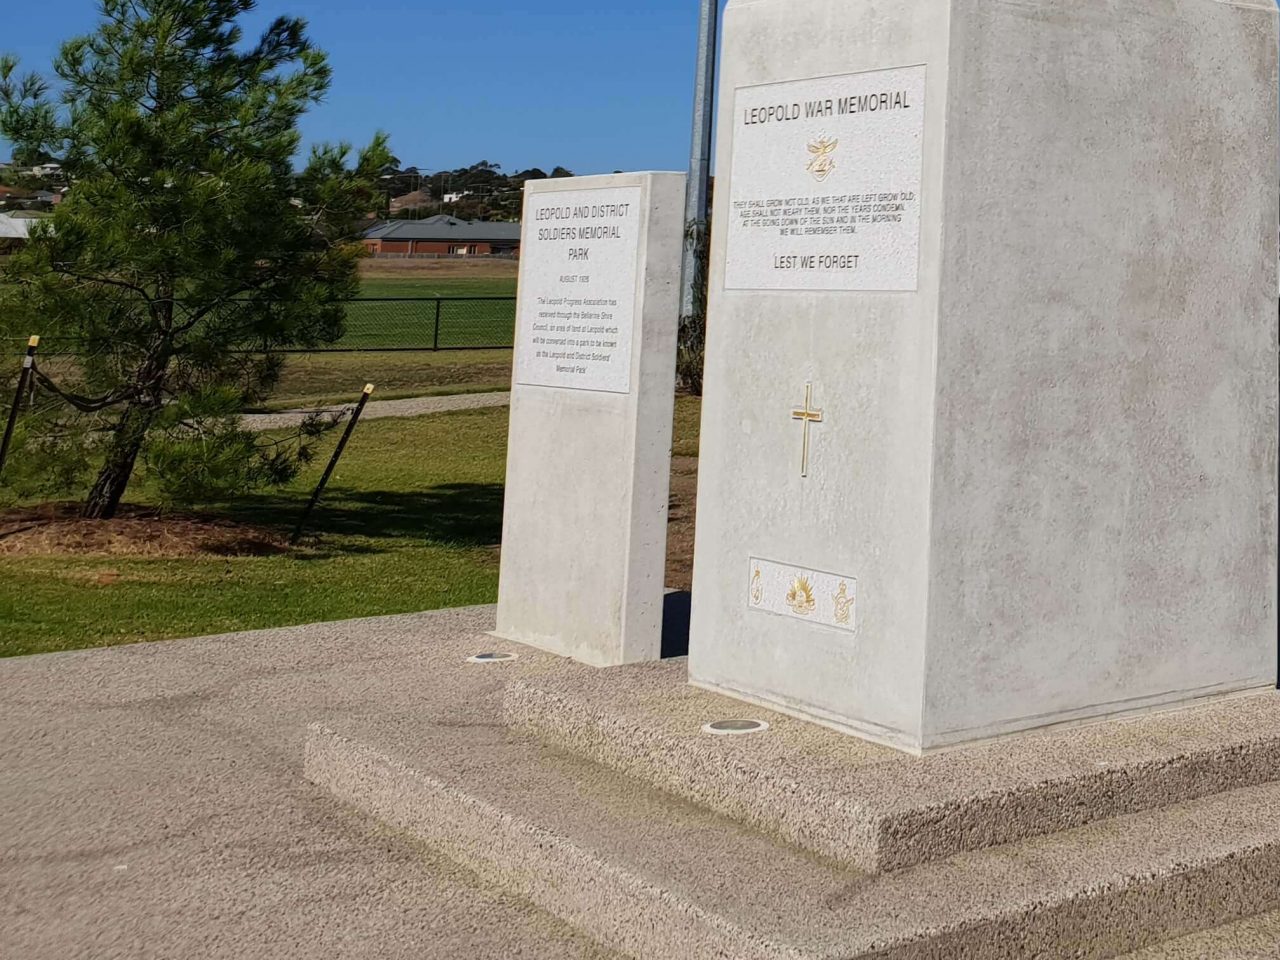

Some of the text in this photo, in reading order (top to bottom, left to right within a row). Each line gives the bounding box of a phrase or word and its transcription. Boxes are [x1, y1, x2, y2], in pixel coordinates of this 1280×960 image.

[744, 91, 911, 125] LEOPOLD WAR MEMORIAL
[536, 204, 629, 221] LEOPOLD AND DISTRICT
[538, 226, 621, 240] SOLDIERS MEMORIAL
[568, 248, 589, 260] PARK
[774, 254, 859, 269] LEST WE FORGET
